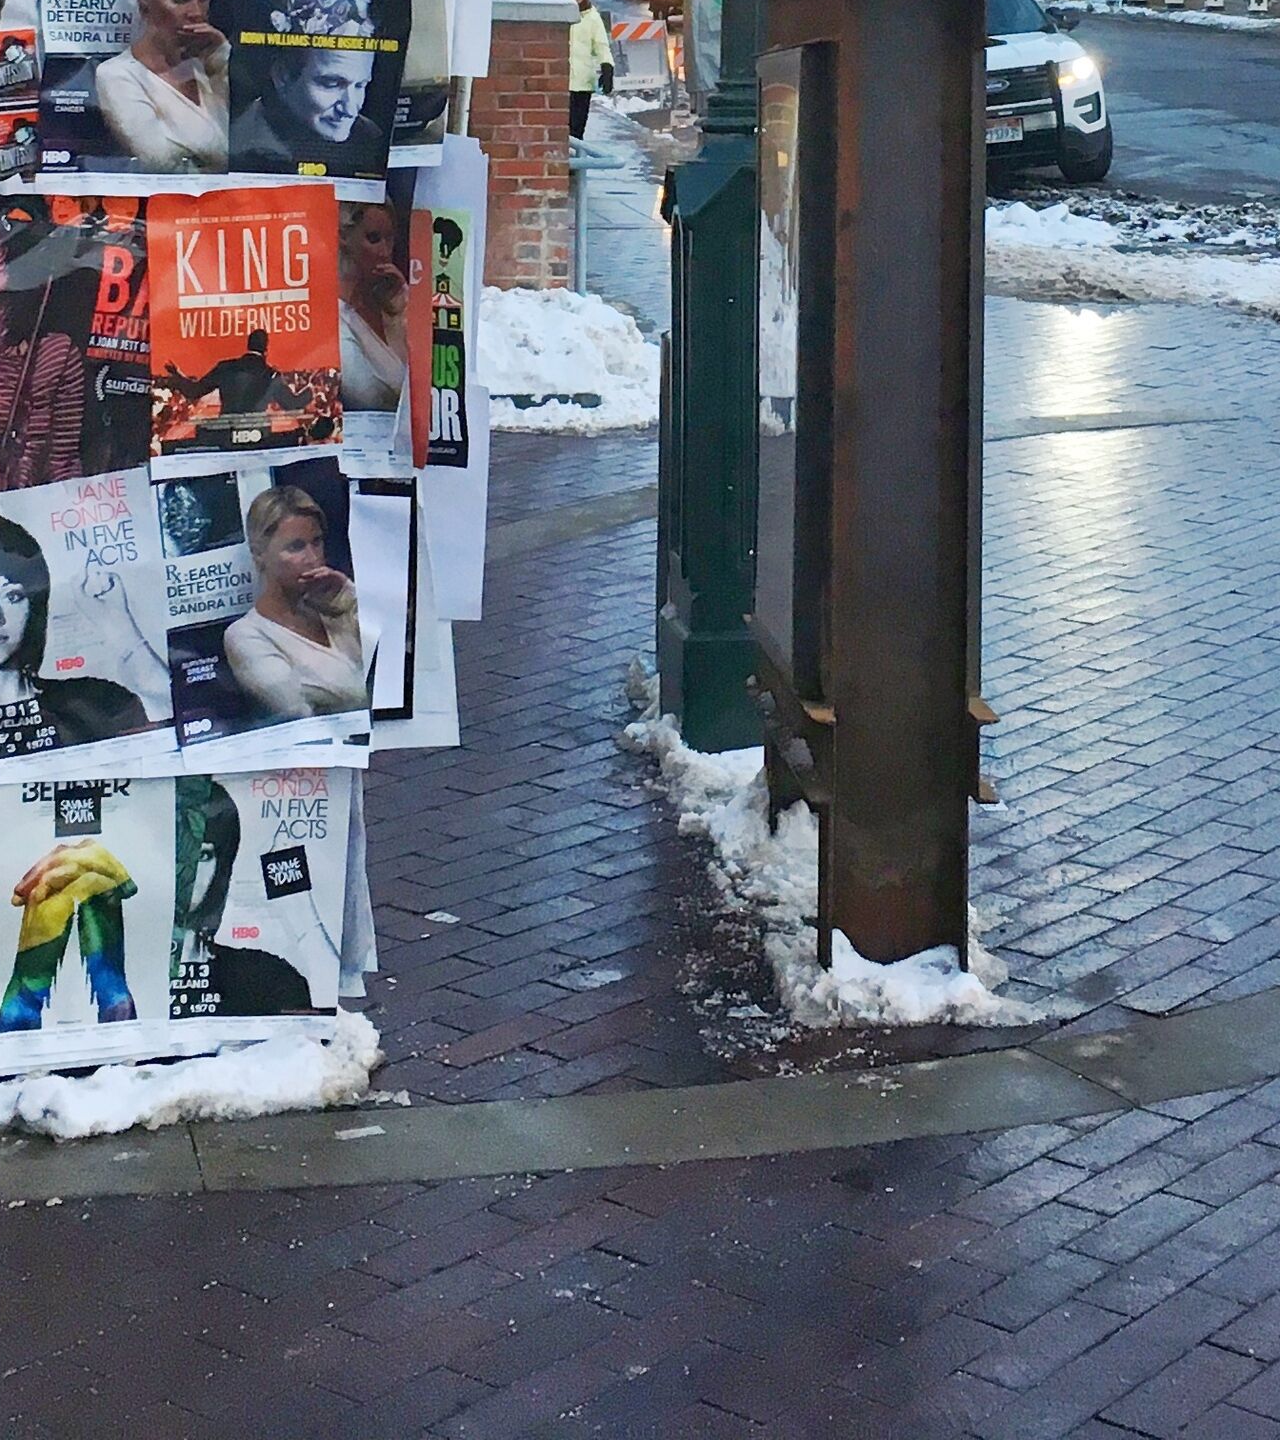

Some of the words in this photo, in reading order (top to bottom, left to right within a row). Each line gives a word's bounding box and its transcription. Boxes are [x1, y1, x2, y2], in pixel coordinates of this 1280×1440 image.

[47, 10, 133, 25] DETECTION
[49, 31, 101, 44] SANDRA
[105, 33, 131, 44] LEE
[42, 150, 71, 164] HBO
[175, 224, 309, 294] KING
[179, 303, 312, 340] WILDERNESS
[231, 429, 262, 444] HBO
[74, 478, 127, 505] JANE
[51, 501, 131, 532] FONDA
[64, 528, 87, 551] IN
[93, 520, 135, 547] FIVE
[86, 541, 138, 569] ACTS
[167, 572, 252, 599] DETECTION
[169, 599, 225, 616] SANDRA
[229, 592, 254, 607] LEE
[183, 718, 212, 736] HBO
[252, 778, 329, 798] FONDA
[60, 809, 95, 825] YOUTH
[260, 799, 282, 819] IN
[287, 798, 329, 819] FIVE
[275, 818, 328, 840] ACTS
[268, 869, 303, 887] YOUTH
[232, 926, 260, 939] HBO
[172, 1005, 181, 1015] 3
[190, 1004, 216, 1013] 1970
